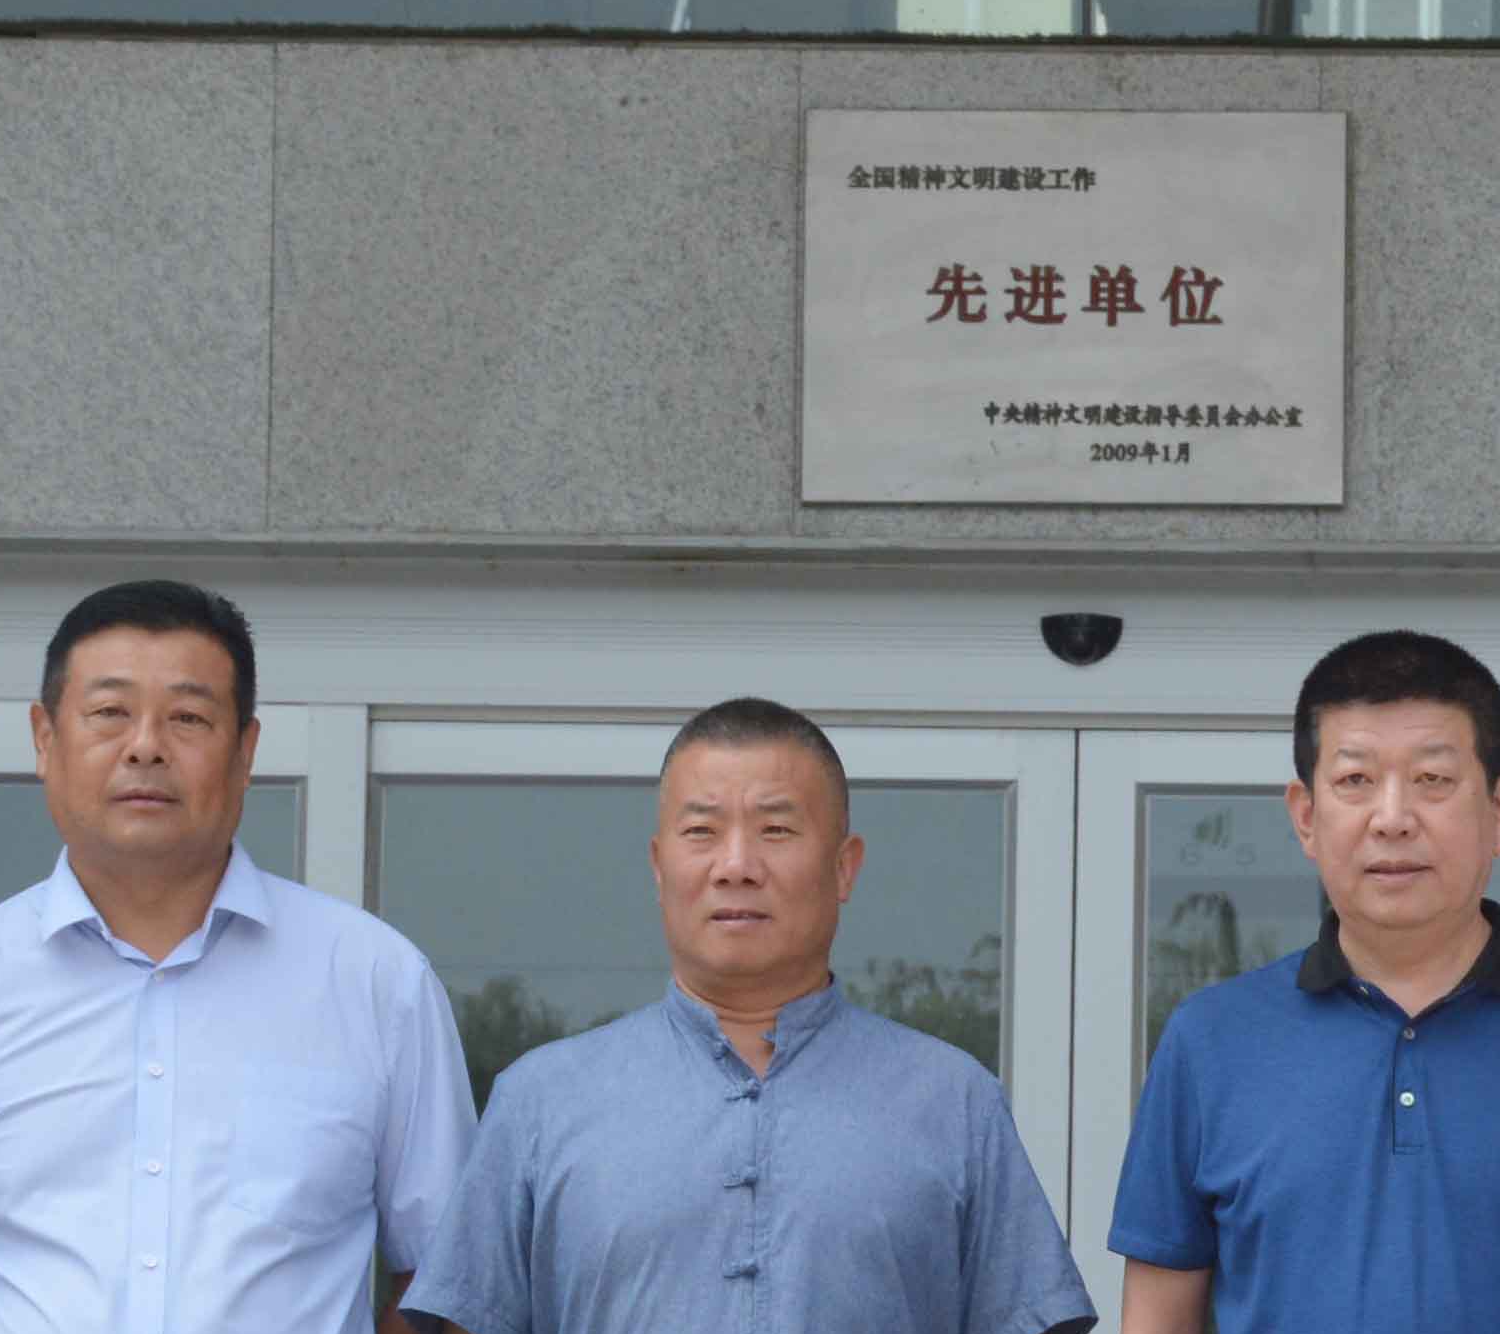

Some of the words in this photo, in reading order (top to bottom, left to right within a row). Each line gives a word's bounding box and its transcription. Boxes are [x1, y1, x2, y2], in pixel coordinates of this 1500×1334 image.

[846, 165, 1097, 192] 全国精神文明建设工作
[925, 262, 1225, 327] 先进单位
[983, 401, 1303, 429] 中央精神文明建设指导委员会办公室
[1090, 442, 1192, 465] 2009年1月
